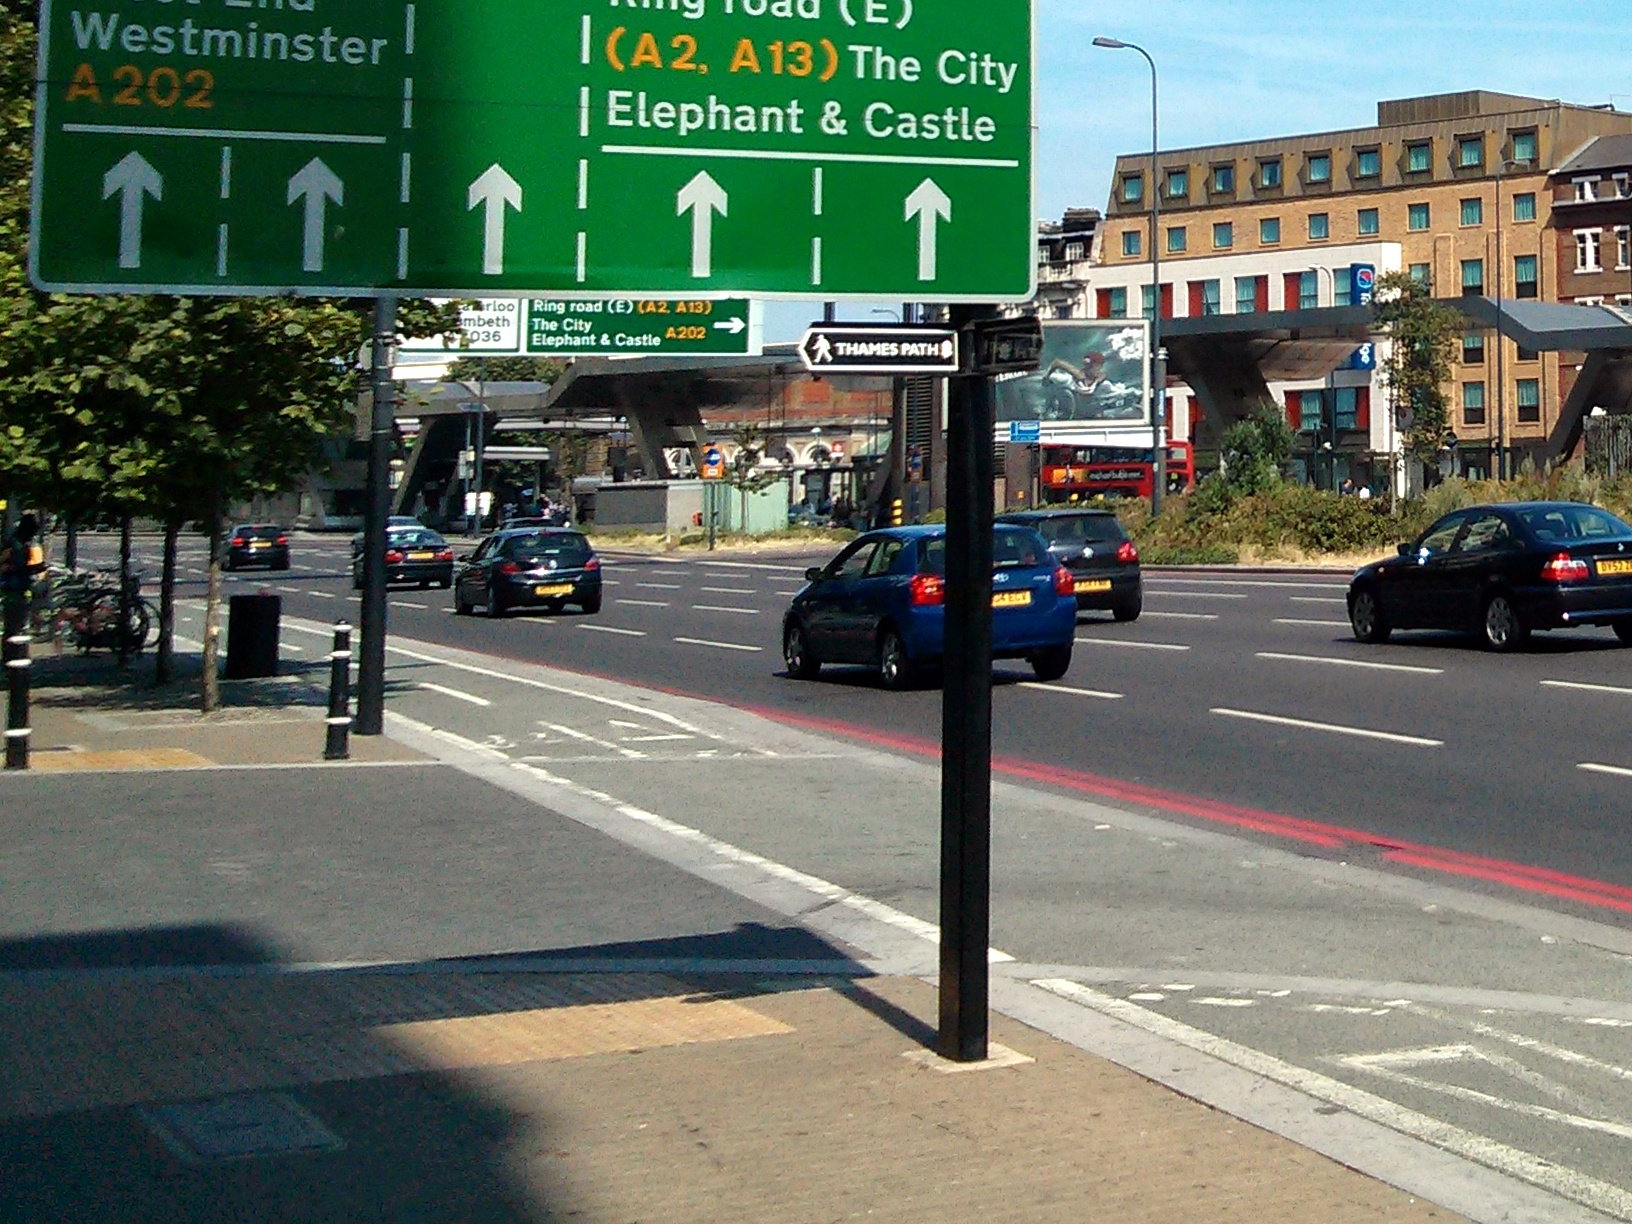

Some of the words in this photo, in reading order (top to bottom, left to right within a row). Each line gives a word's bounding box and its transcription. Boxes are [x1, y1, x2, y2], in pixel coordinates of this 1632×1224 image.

[70, 10, 388, 66] Westminster
[605, 26, 709, 75] (A2,
[728, 37, 839, 83] A13)
[848, 44, 922, 82] The
[936, 49, 1019, 94] City
[64, 62, 216, 110] A202
[606, 89, 805, 137] Elephant
[818, 100, 849, 136] &
[863, 100, 997, 142] Castle
[533, 299, 565, 314] Ring
[569, 299, 603, 313] road
[607, 299, 634, 314] (E)
[674, 300, 712, 315] A13)
[532, 318, 558, 332] The
[562, 317, 593, 334] City
[664, 326, 706, 340] A202
[532, 333, 596, 348] Elephant
[600, 333, 611, 346] &
[614, 333, 662, 346] Castle
[834, 342, 899, 357] THAMES
[900, 342, 940, 357] PATH
